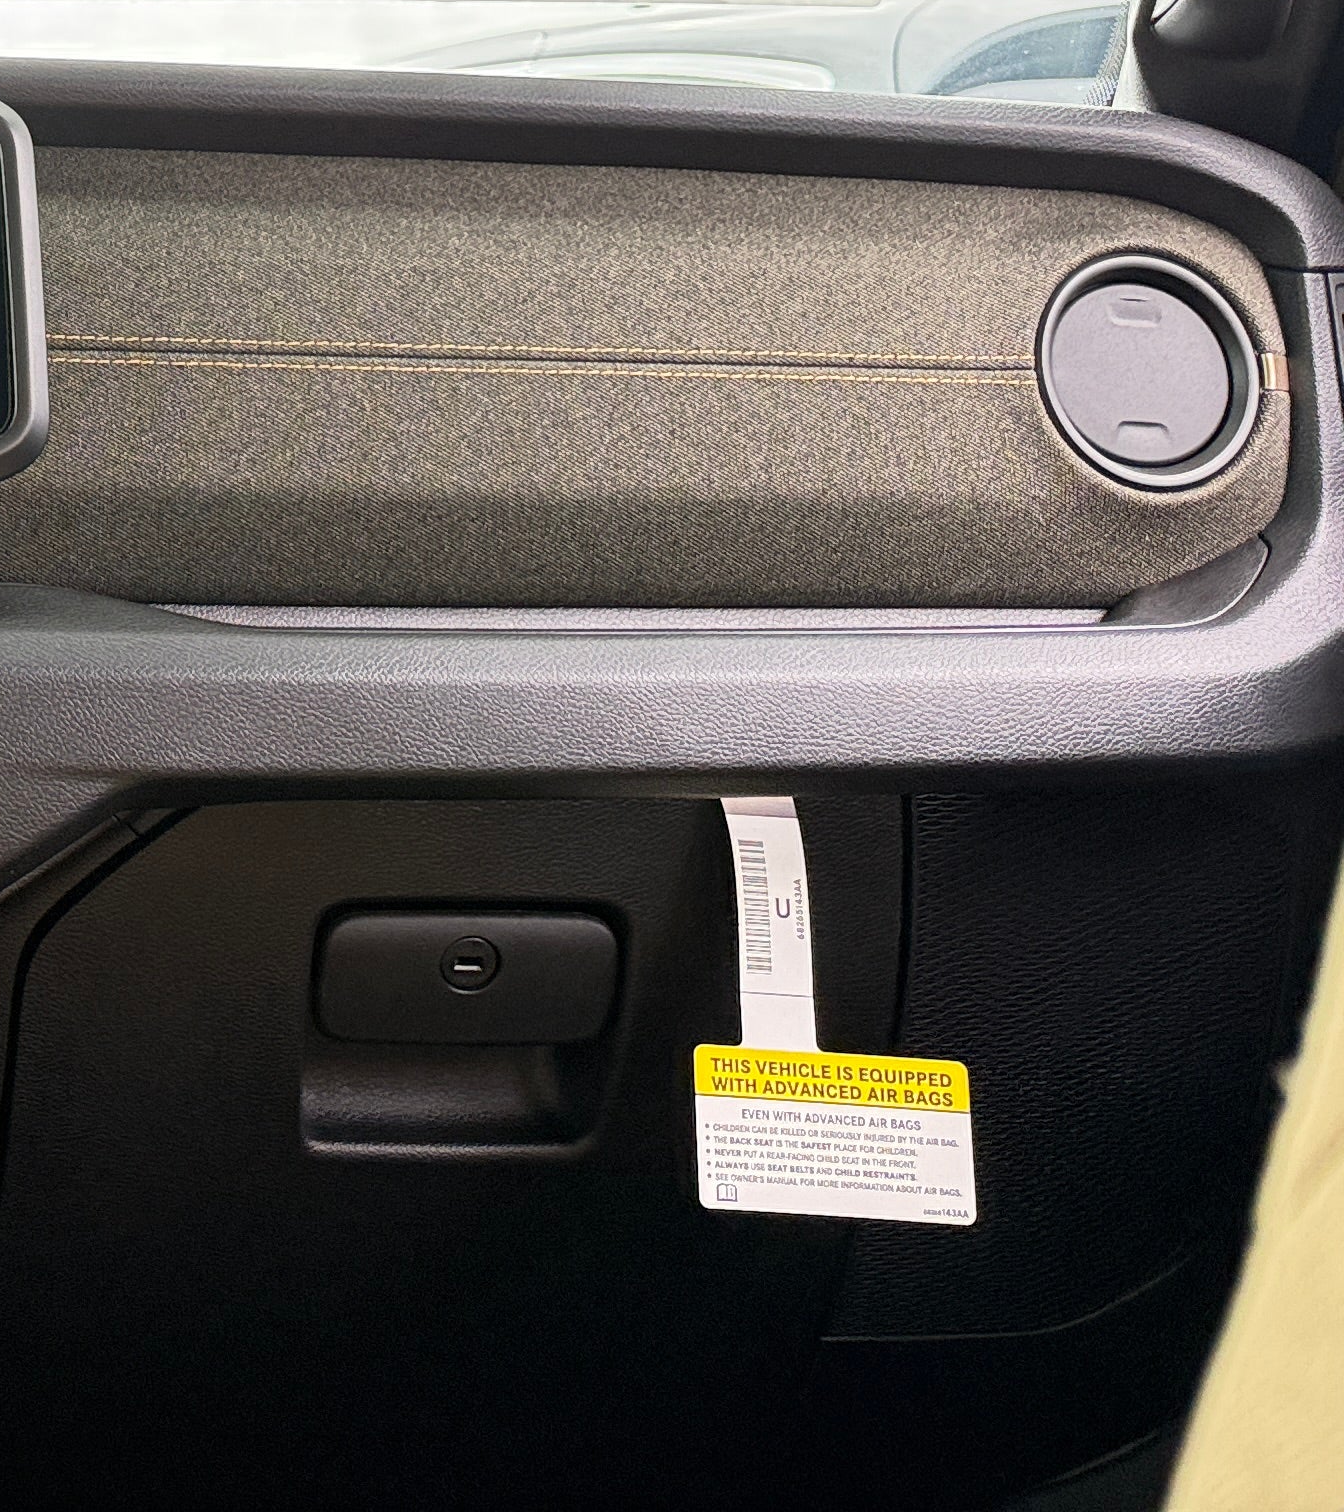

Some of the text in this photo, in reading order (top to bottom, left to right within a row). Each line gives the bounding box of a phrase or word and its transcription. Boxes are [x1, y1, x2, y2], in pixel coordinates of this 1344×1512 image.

[775, 897, 790, 919] U
[711, 1057, 952, 1088] THIS VEHICLE IS EQUIPPED
[711, 1076, 953, 1107] WITH ADVANCED AIR BAGS
[741, 1108, 921, 1131] EVEN WITH ADVANCED AIR BAGS
[714, 1135, 728, 1144] THE
[730, 1137, 752, 1145] BACK
[754, 1138, 774, 1147] SEAT
[785, 1140, 799, 1148] THE
[801, 1141, 831, 1150] SAFEST
[834, 1143, 857, 1152] PLACE
[860, 1145, 874, 1154] FOR
[715, 1161, 749, 1170] ALWAYS
[750, 1162, 765, 1171] USE
[767, 1163, 788, 1172] SEAT
[790, 1165, 814, 1174] BELTS
[816, 1167, 832, 1175] AND
[835, 1168, 860, 1177] CHILD
